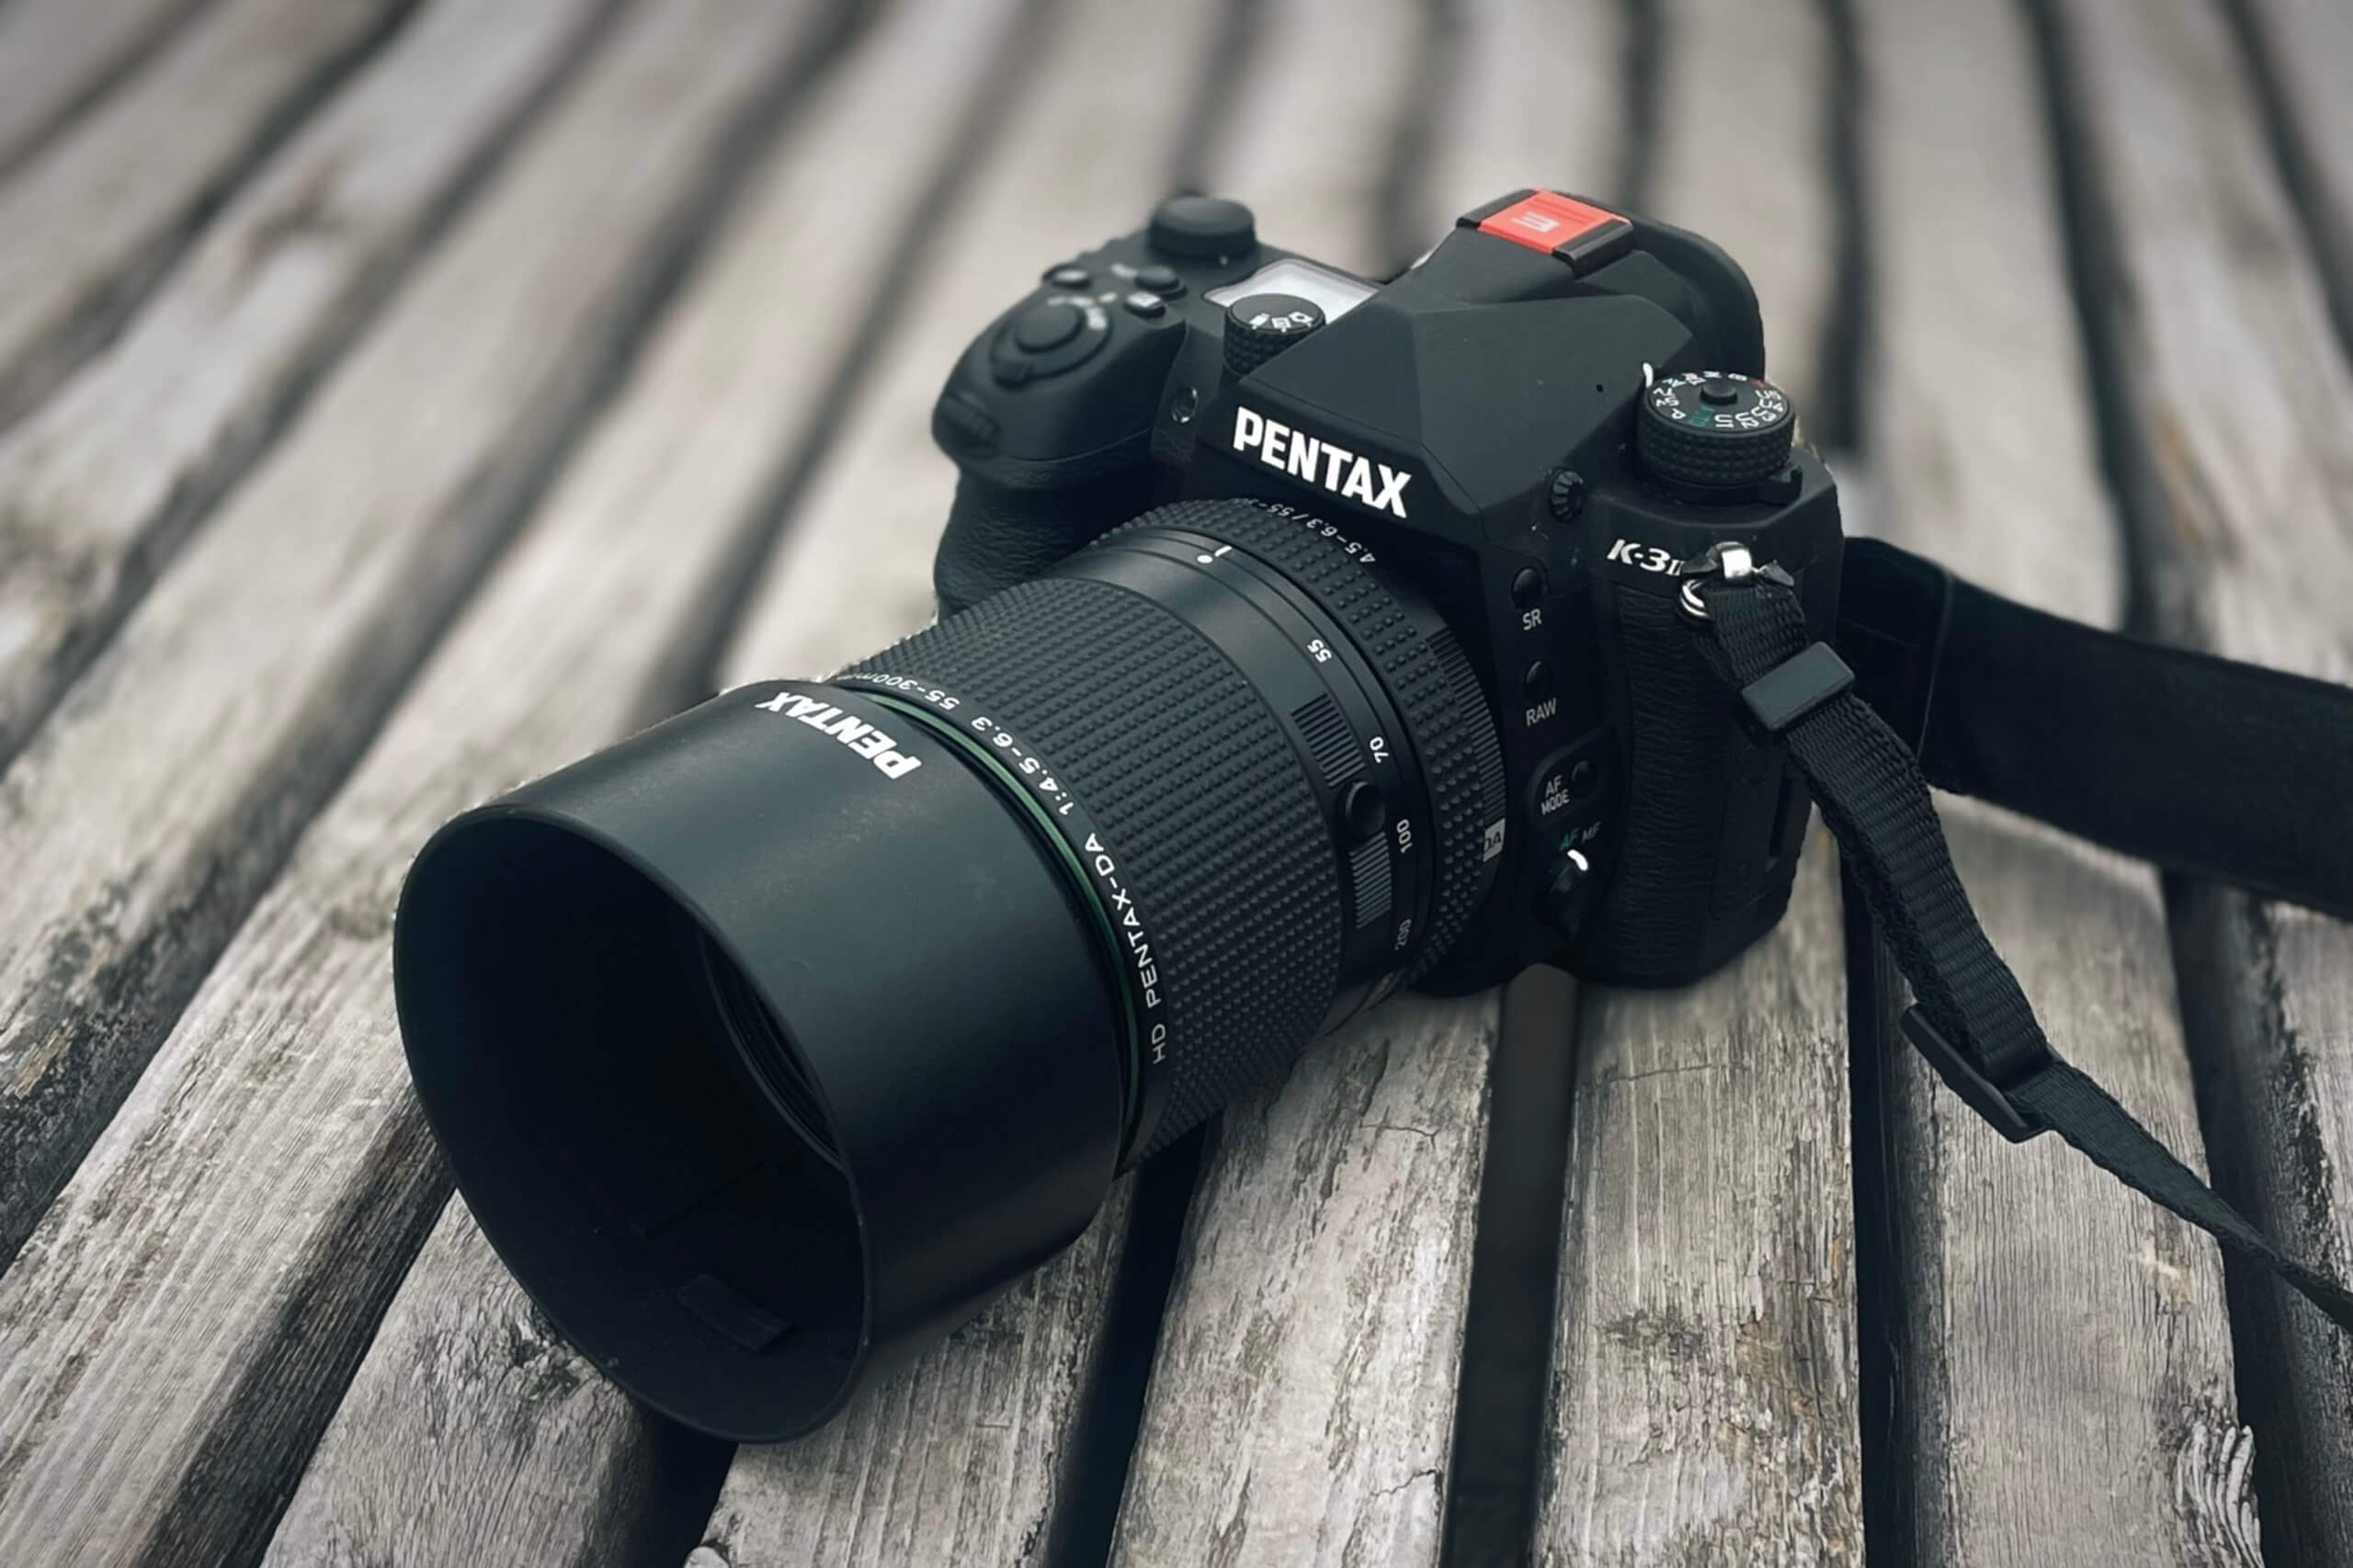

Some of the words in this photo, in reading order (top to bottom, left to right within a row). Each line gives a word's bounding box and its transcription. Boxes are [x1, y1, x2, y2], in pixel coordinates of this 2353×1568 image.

[1671, 408, 1687, 420] P
[1233, 406, 1413, 518] PENTAX
[1522, 608, 1542, 631] SR
[1307, 639, 1332, 663] 55
[1526, 698, 1557, 727] RAW
[755, 691, 922, 779] PENTAX
[1370, 736, 1389, 764] 70
[971, 716, 1074, 815] 1:4.5-6.3
[1545, 775, 1563, 798] AF
[1540, 789, 1570, 815] MODE
[1396, 819, 1413, 854] 100
[1085, 833, 1161, 1007] PENTAX-DA
[1151, 1023, 1166, 1064] HD
